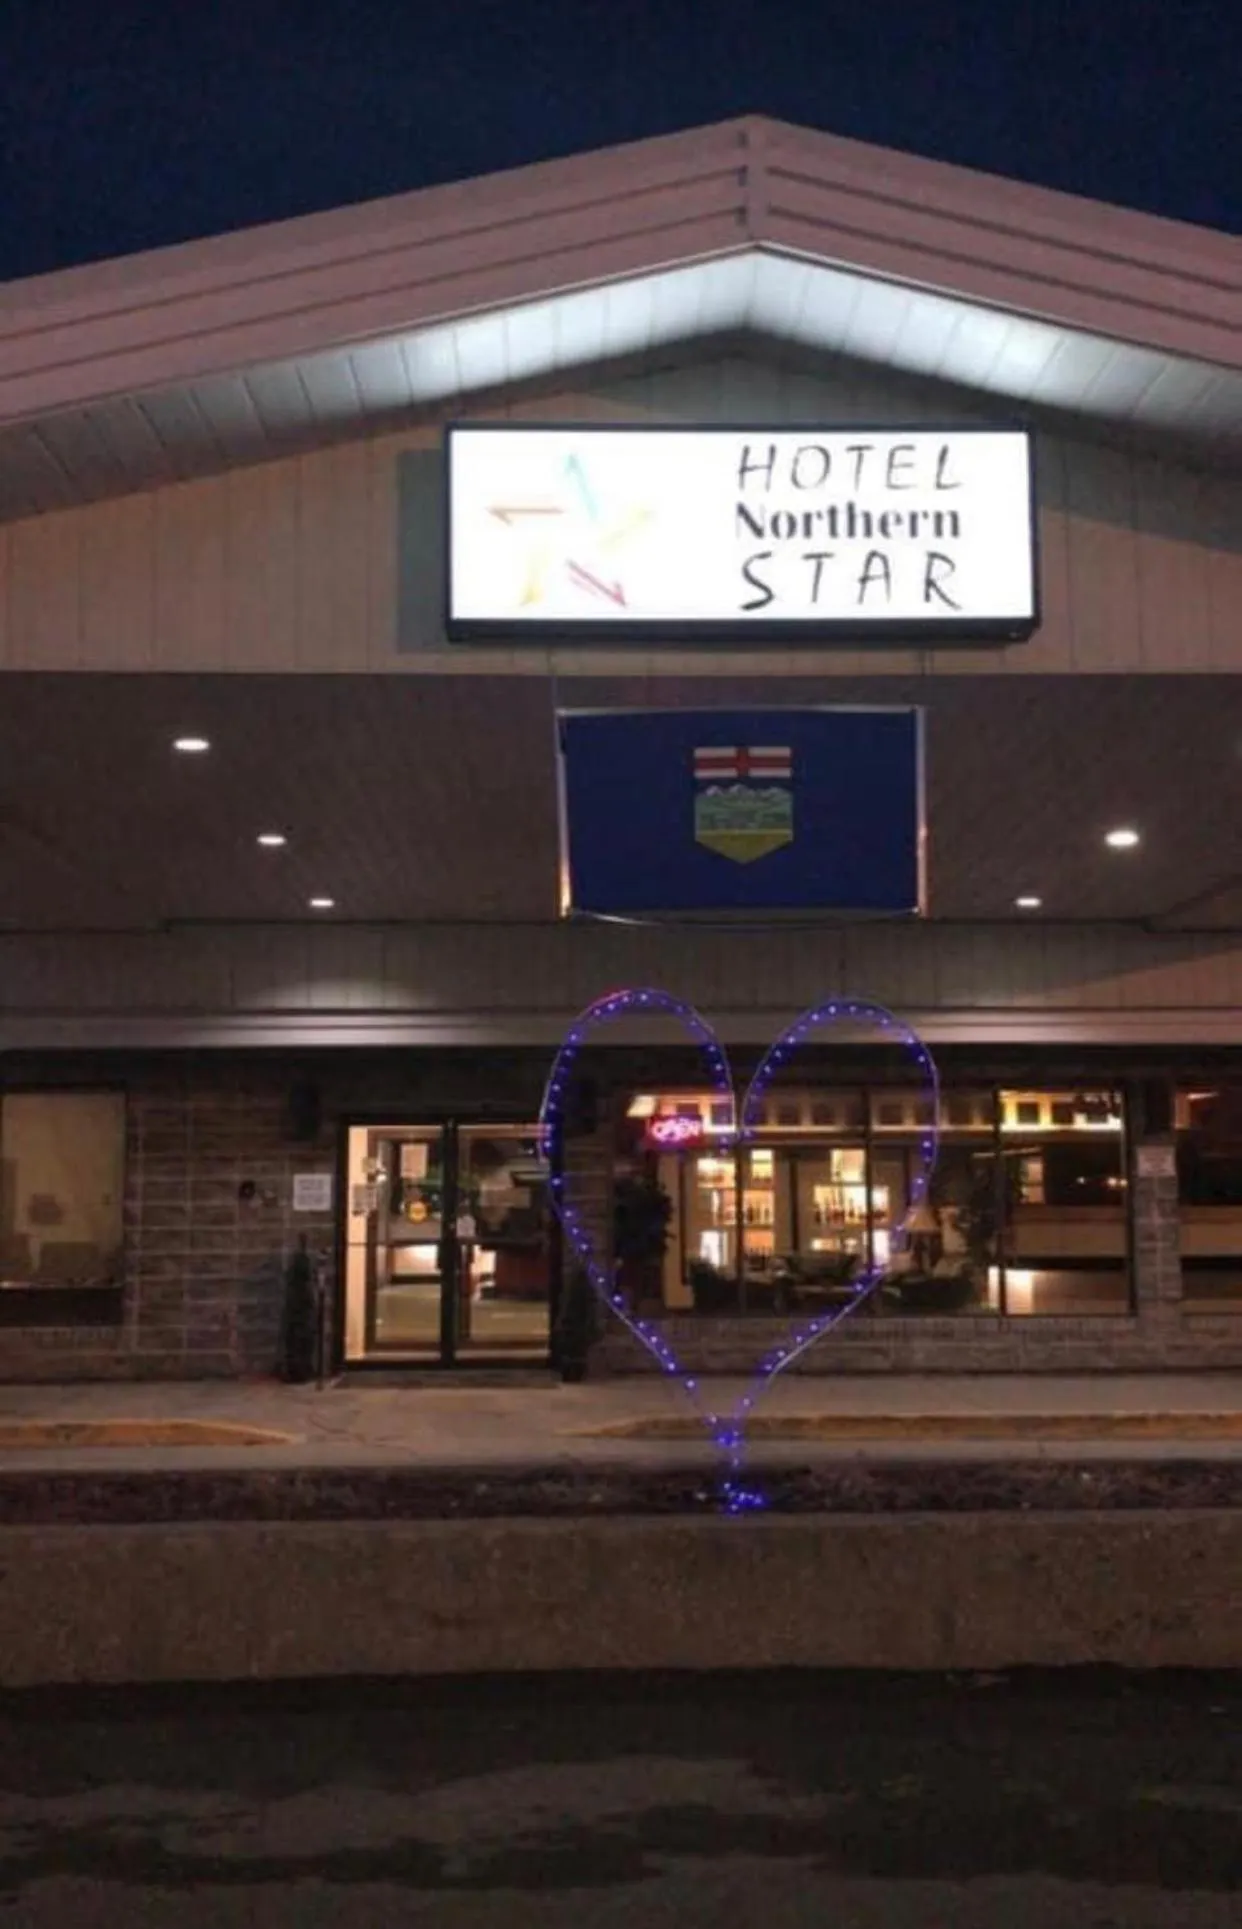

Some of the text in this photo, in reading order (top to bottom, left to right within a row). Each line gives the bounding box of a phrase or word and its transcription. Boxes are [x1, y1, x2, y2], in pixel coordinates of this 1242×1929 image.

[738, 444, 962, 492] HOTEL
[735, 500, 960, 539] Northern
[738, 549, 962, 611] STAR
